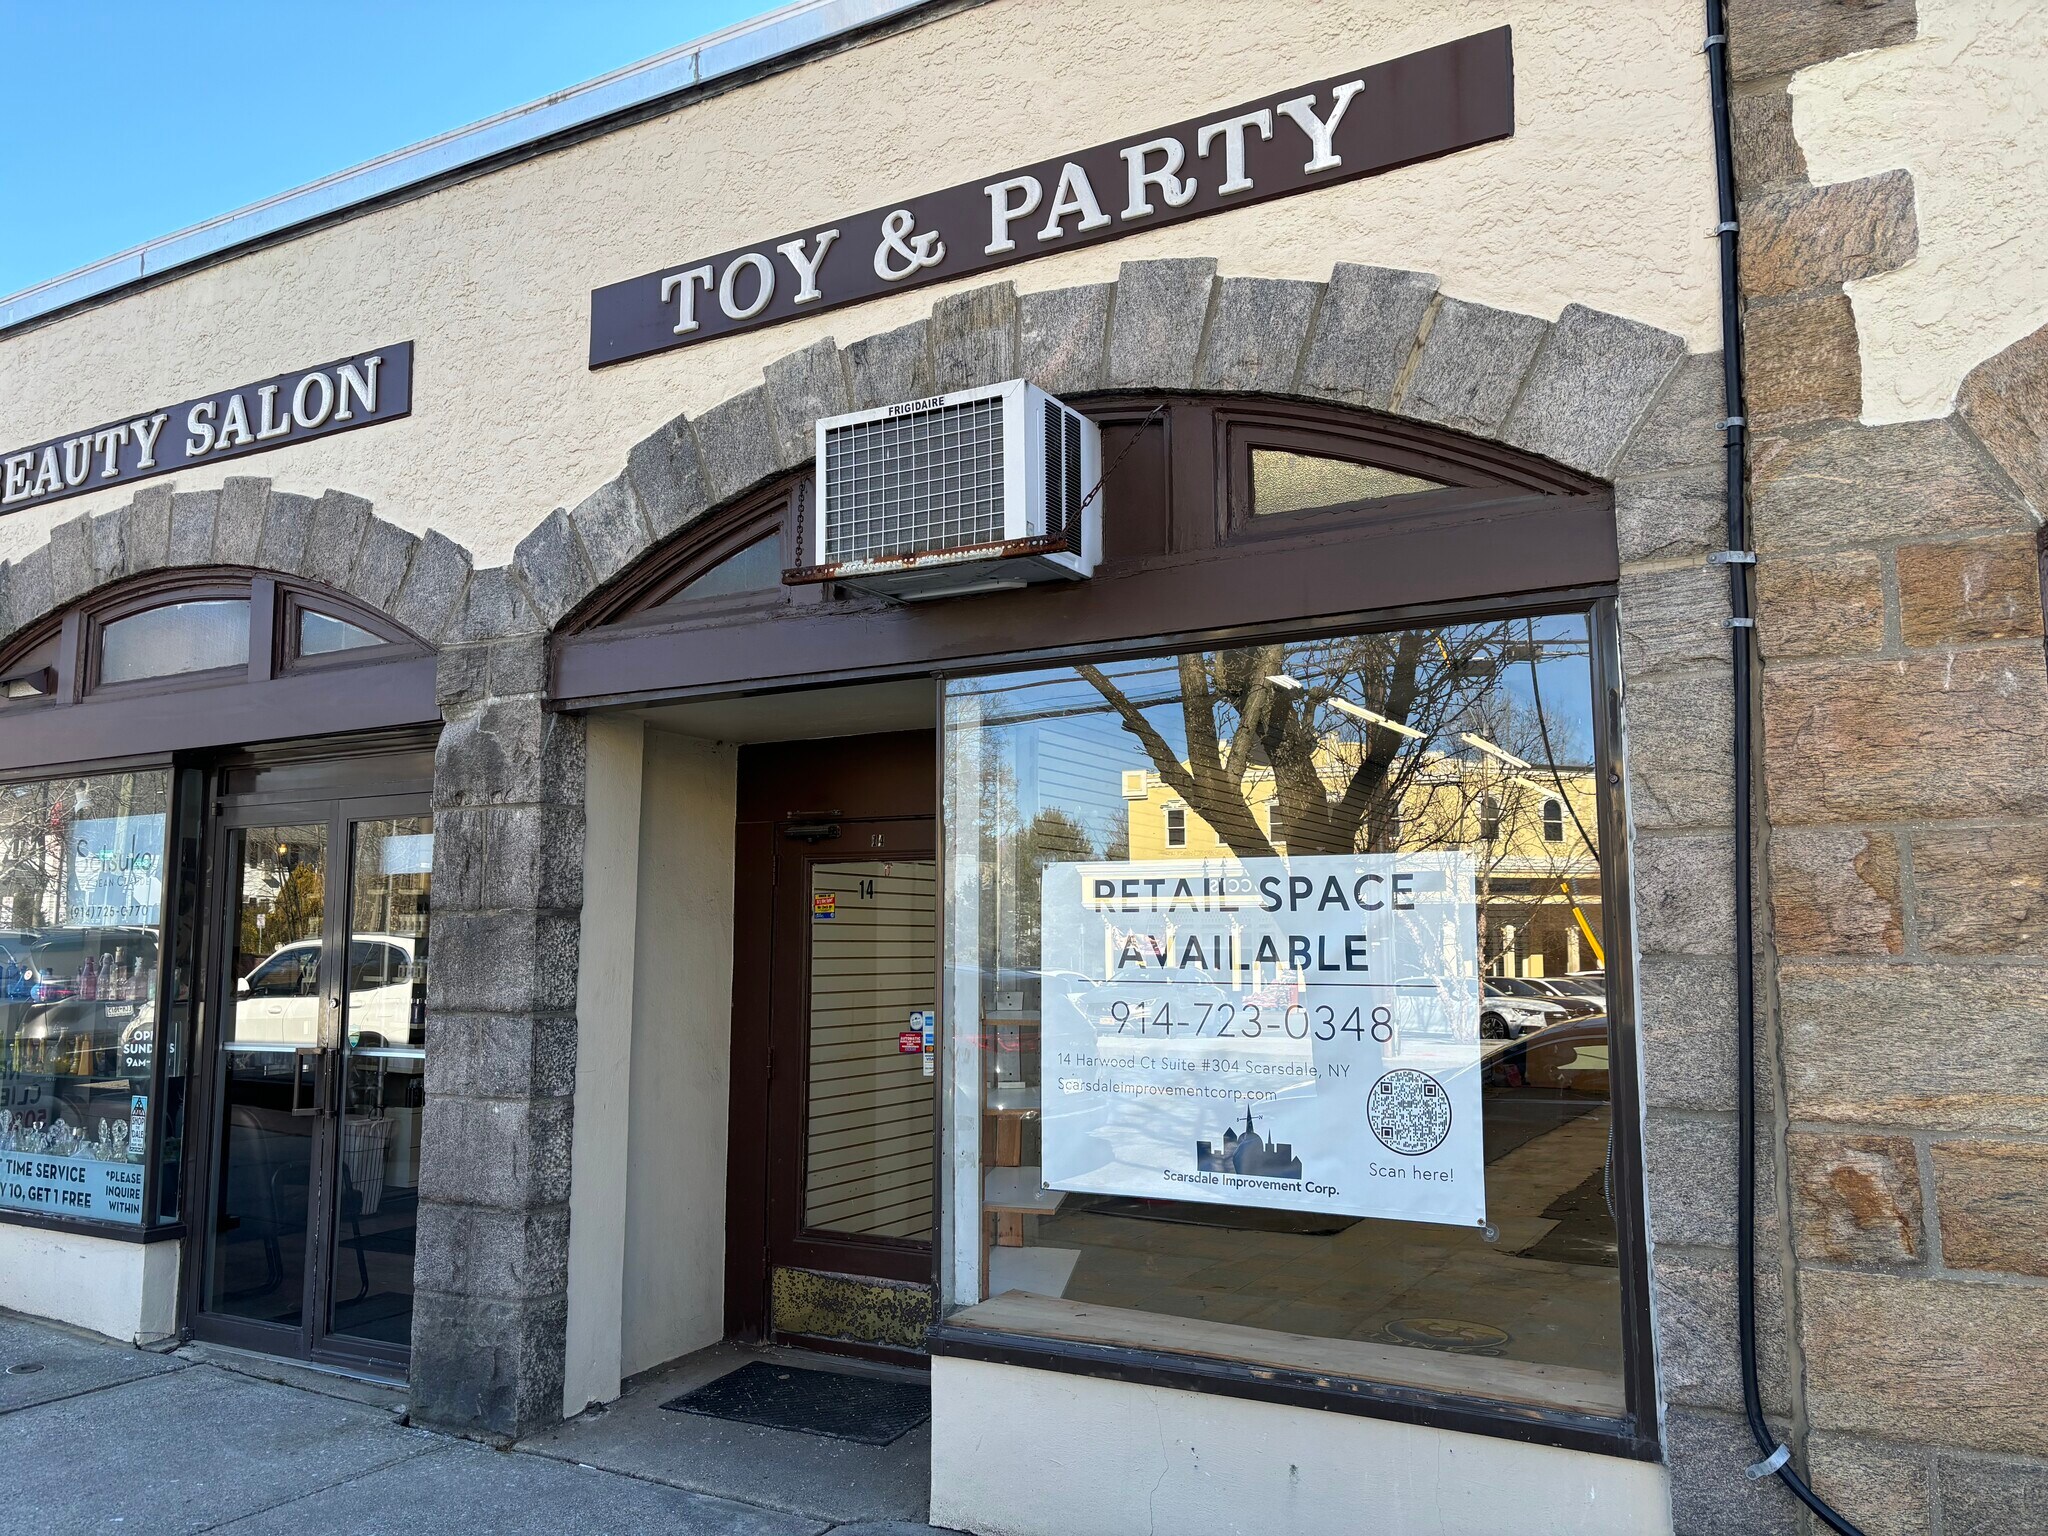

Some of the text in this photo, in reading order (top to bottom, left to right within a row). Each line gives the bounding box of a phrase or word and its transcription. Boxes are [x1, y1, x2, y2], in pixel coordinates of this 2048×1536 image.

[660, 79, 1366, 335] TOY & PARTY
[888, 396, 945, 416] FRIGIDAIRE
[0, 356, 382, 505] EAUTY SALON
[859, 879, 874, 899] 14
[1094, 873, 1416, 913] RETAIL SPACE
[1117, 934, 1369, 972] AVAILABLE
[1111, 999, 1394, 1043] 914-723-0348
[1057, 1053, 1351, 1078] 14 Harwood Ct Suite #304 Scarsdale, NY
[1057, 1077, 1277, 1100] Scarsdaleimprovementcorp.com
[132, 1117, 145, 1125] SHOP
[131, 1130, 144, 1138] DALE
[6, 1159, 86, 1183] TIME SERVICE
[1369, 1163, 1454, 1183] Scan here!
[105, 1185, 140, 1199] INQUIRE
[1163, 1170, 1340, 1197] Scarsdale Improvement Corp.
[9, 1184, 25, 1202] 10,
[28, 1186, 51, 1203] GET
[54, 1189, 58, 1205] 1
[62, 1190, 91, 1209] FREE
[109, 1200, 140, 1214] WITHIN
